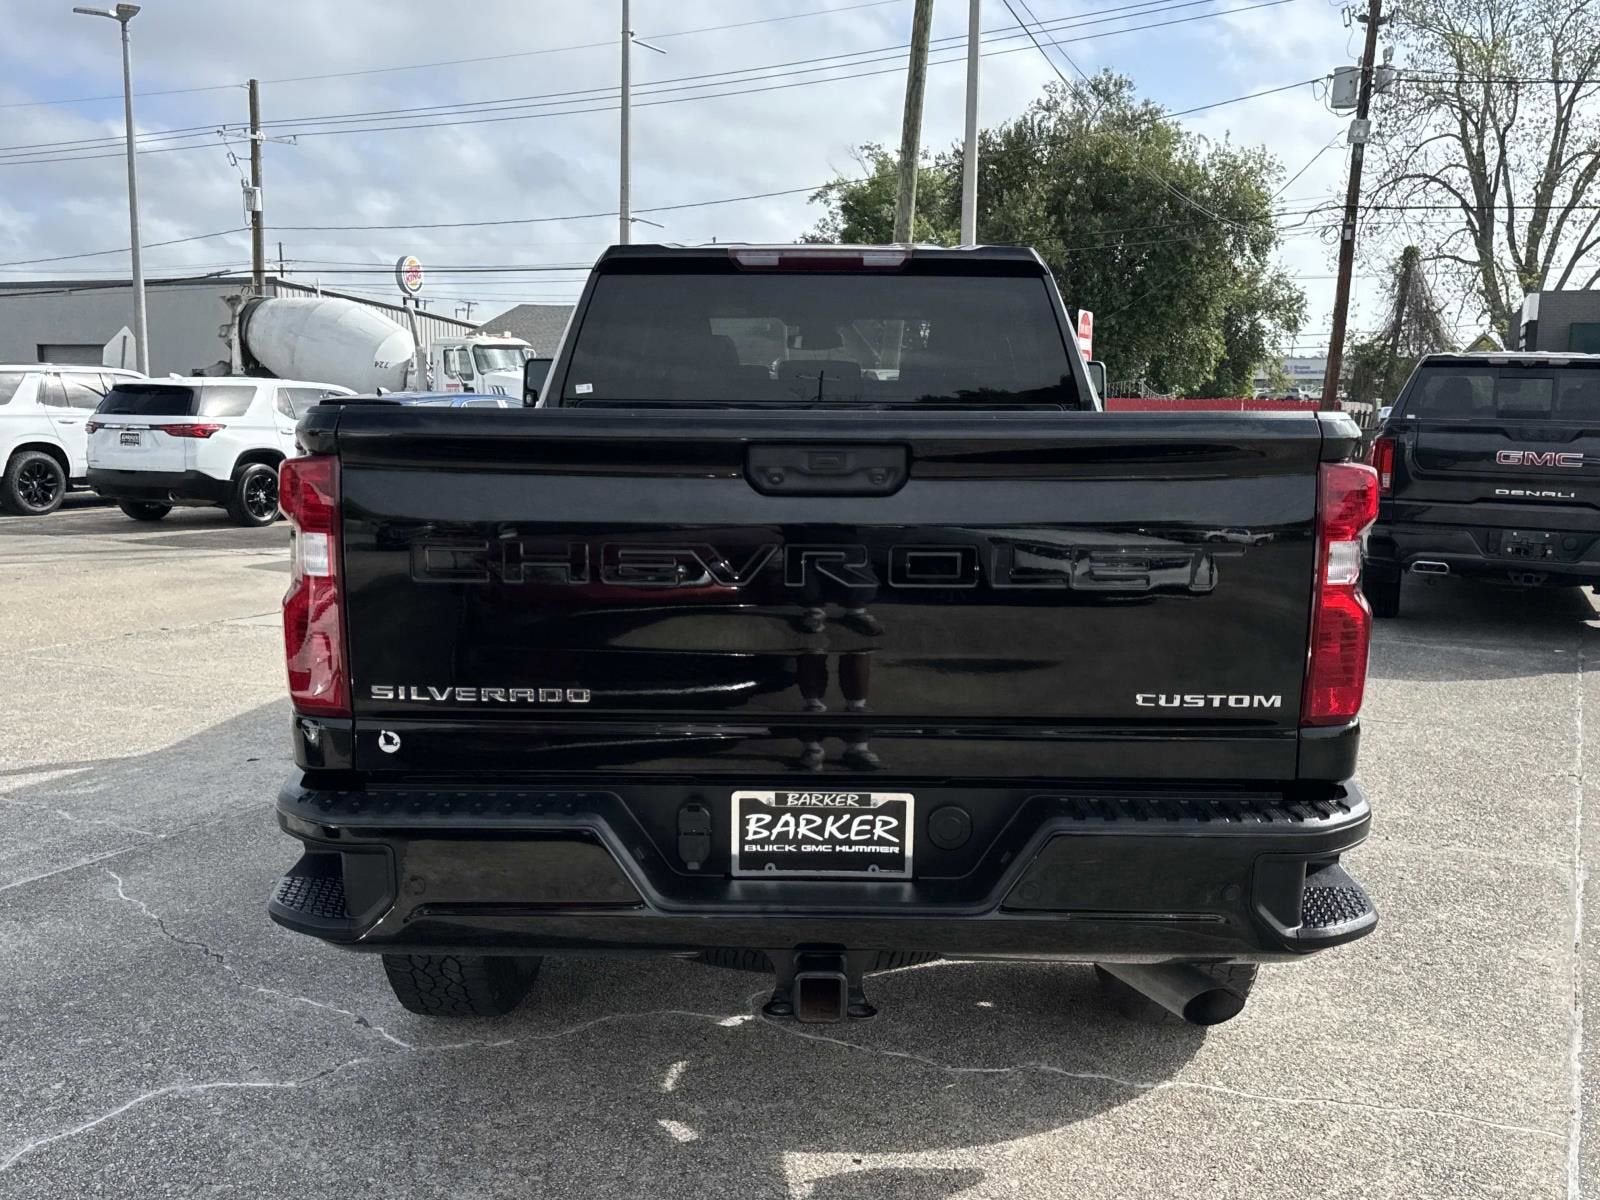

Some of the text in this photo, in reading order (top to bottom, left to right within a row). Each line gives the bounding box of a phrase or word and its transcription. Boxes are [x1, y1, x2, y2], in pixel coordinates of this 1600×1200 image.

[374, 360, 389, 369] 724
[1495, 450, 1584, 468] GMC
[1495, 488, 1575, 498] DENALI
[409, 540, 1247, 593] CHEVROLET
[370, 684, 591, 703] SILVERADO
[1135, 693, 1282, 708] CUSTOM
[786, 793, 859, 807] BARKER
[744, 813, 900, 843] BARKER
[744, 844, 900, 854] BUICK GMC HUMMER
